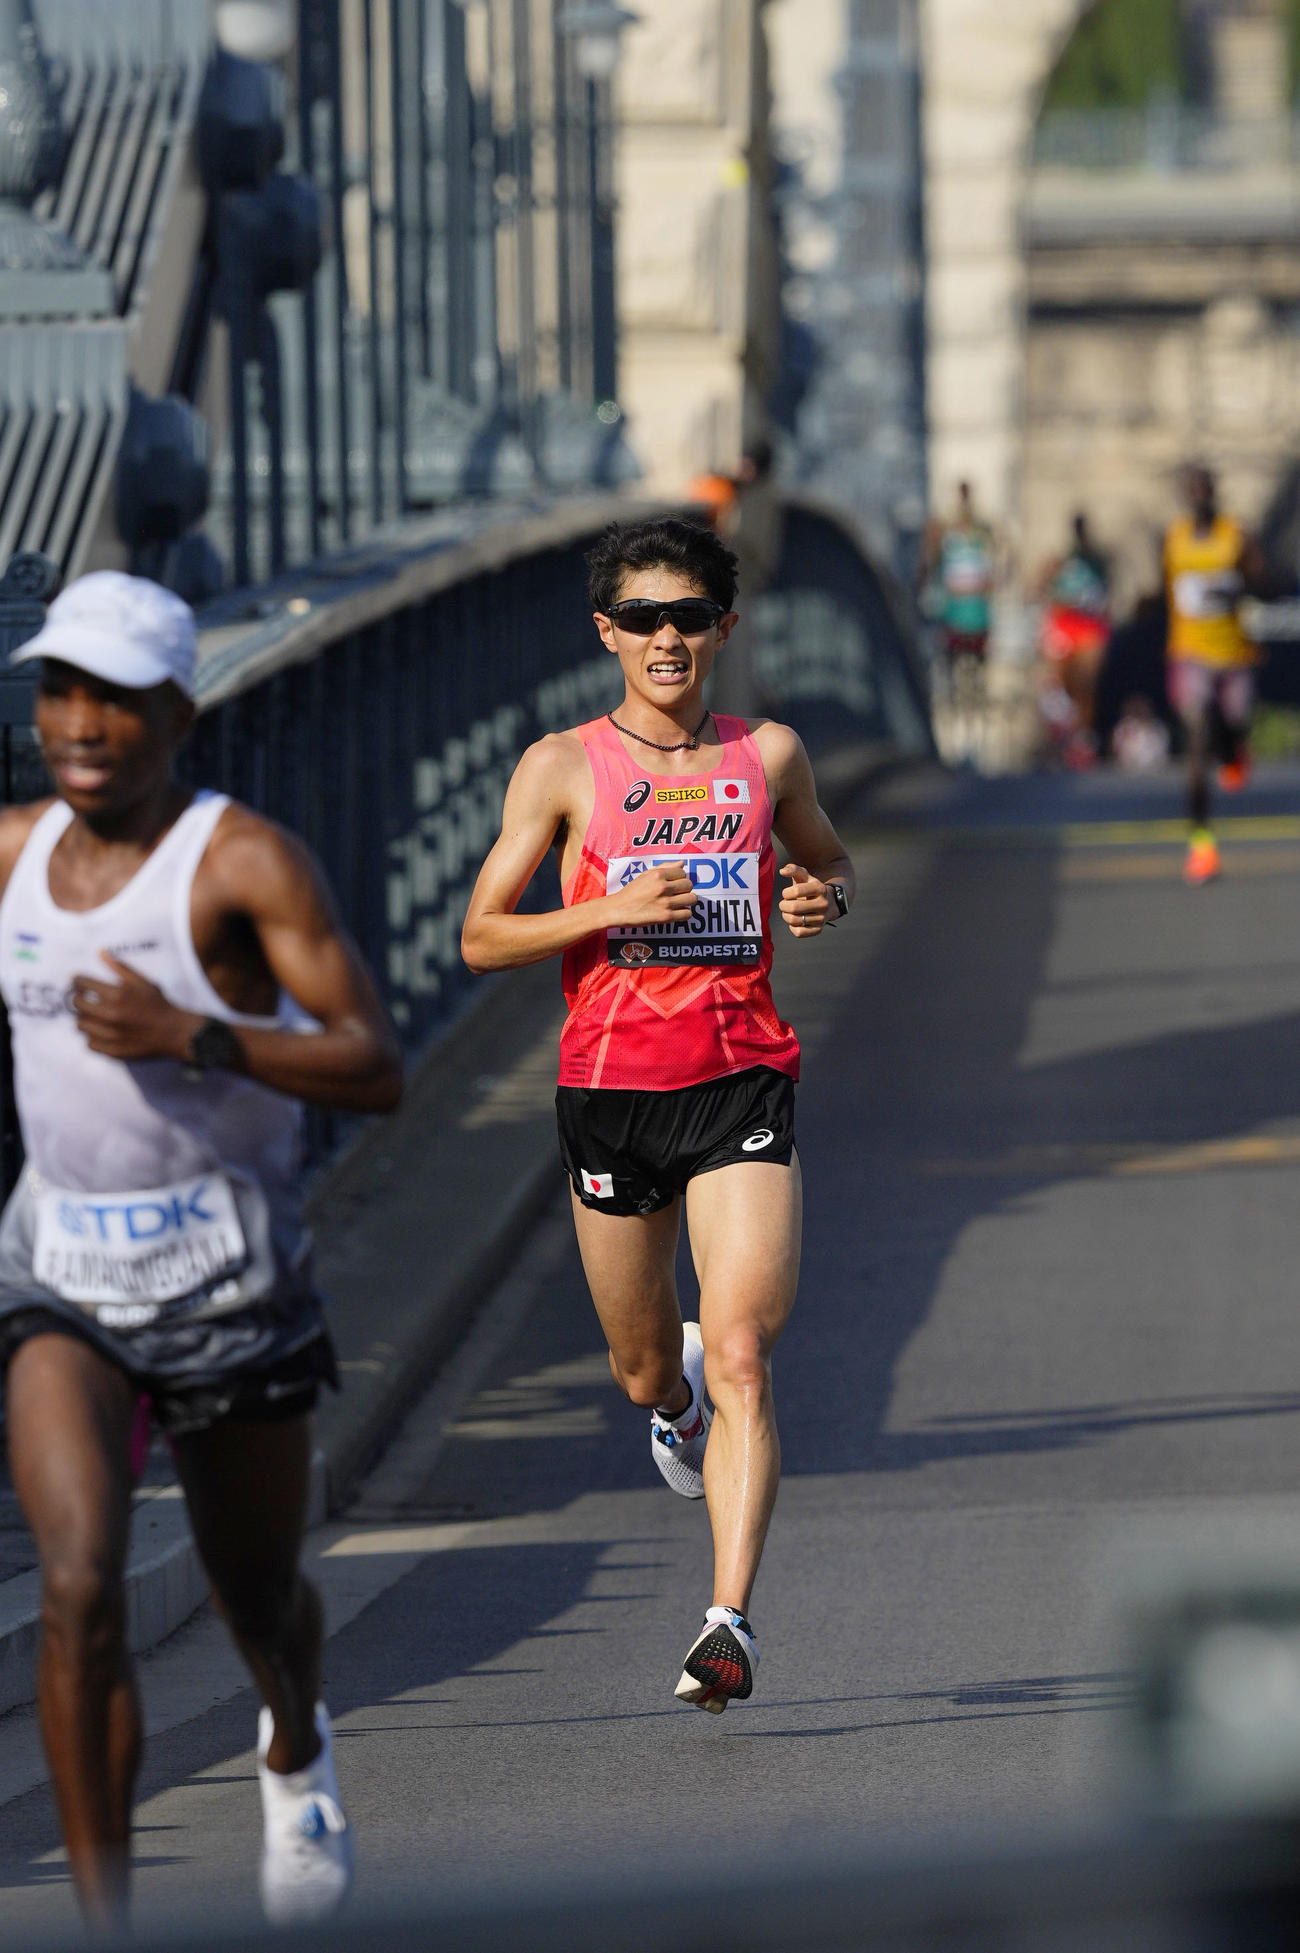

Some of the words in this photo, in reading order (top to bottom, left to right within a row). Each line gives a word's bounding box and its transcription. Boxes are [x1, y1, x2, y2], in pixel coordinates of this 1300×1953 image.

[656, 788, 706, 802] SEIKO
[632, 813, 744, 847] JAPAN
[619, 898, 757, 935] SHITA
[658, 944, 741, 958] BUDAPEST
